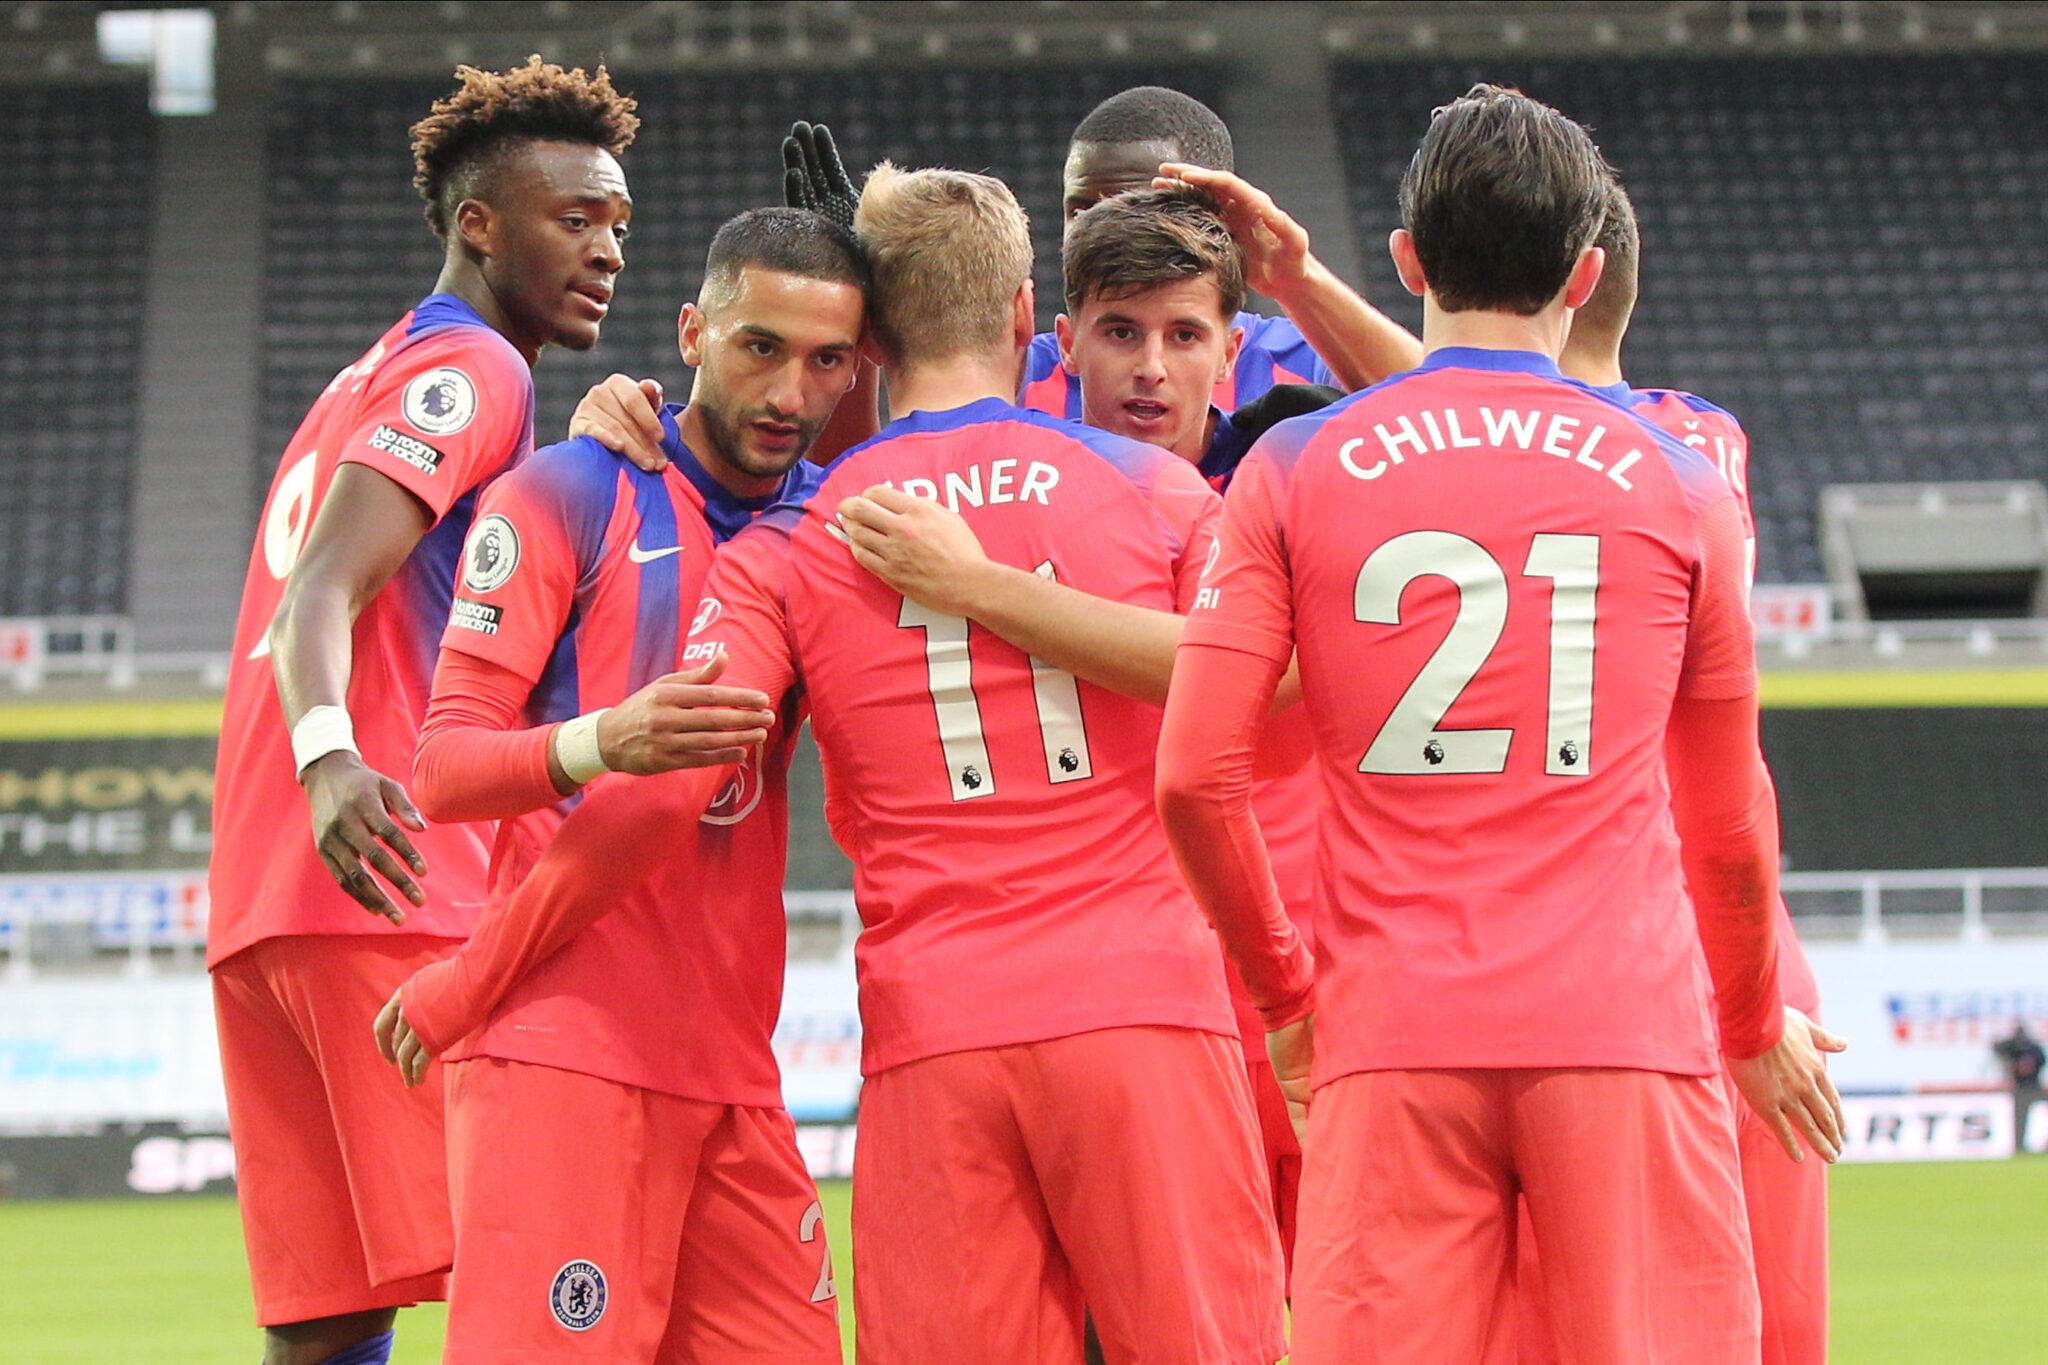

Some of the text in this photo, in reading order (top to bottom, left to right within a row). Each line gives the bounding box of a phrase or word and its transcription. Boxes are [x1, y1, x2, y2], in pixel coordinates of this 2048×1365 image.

[374, 425, 437, 463] No room
[388, 443, 437, 475] racism
[1339, 407, 1642, 491] CHILWELL
[463, 602, 496, 621] room
[1353, 529, 1601, 776] 21
[897, 559, 1093, 803] 11
[1843, 1112, 1992, 1144] RTS
[563, 1264, 600, 1280] CHELSEA
